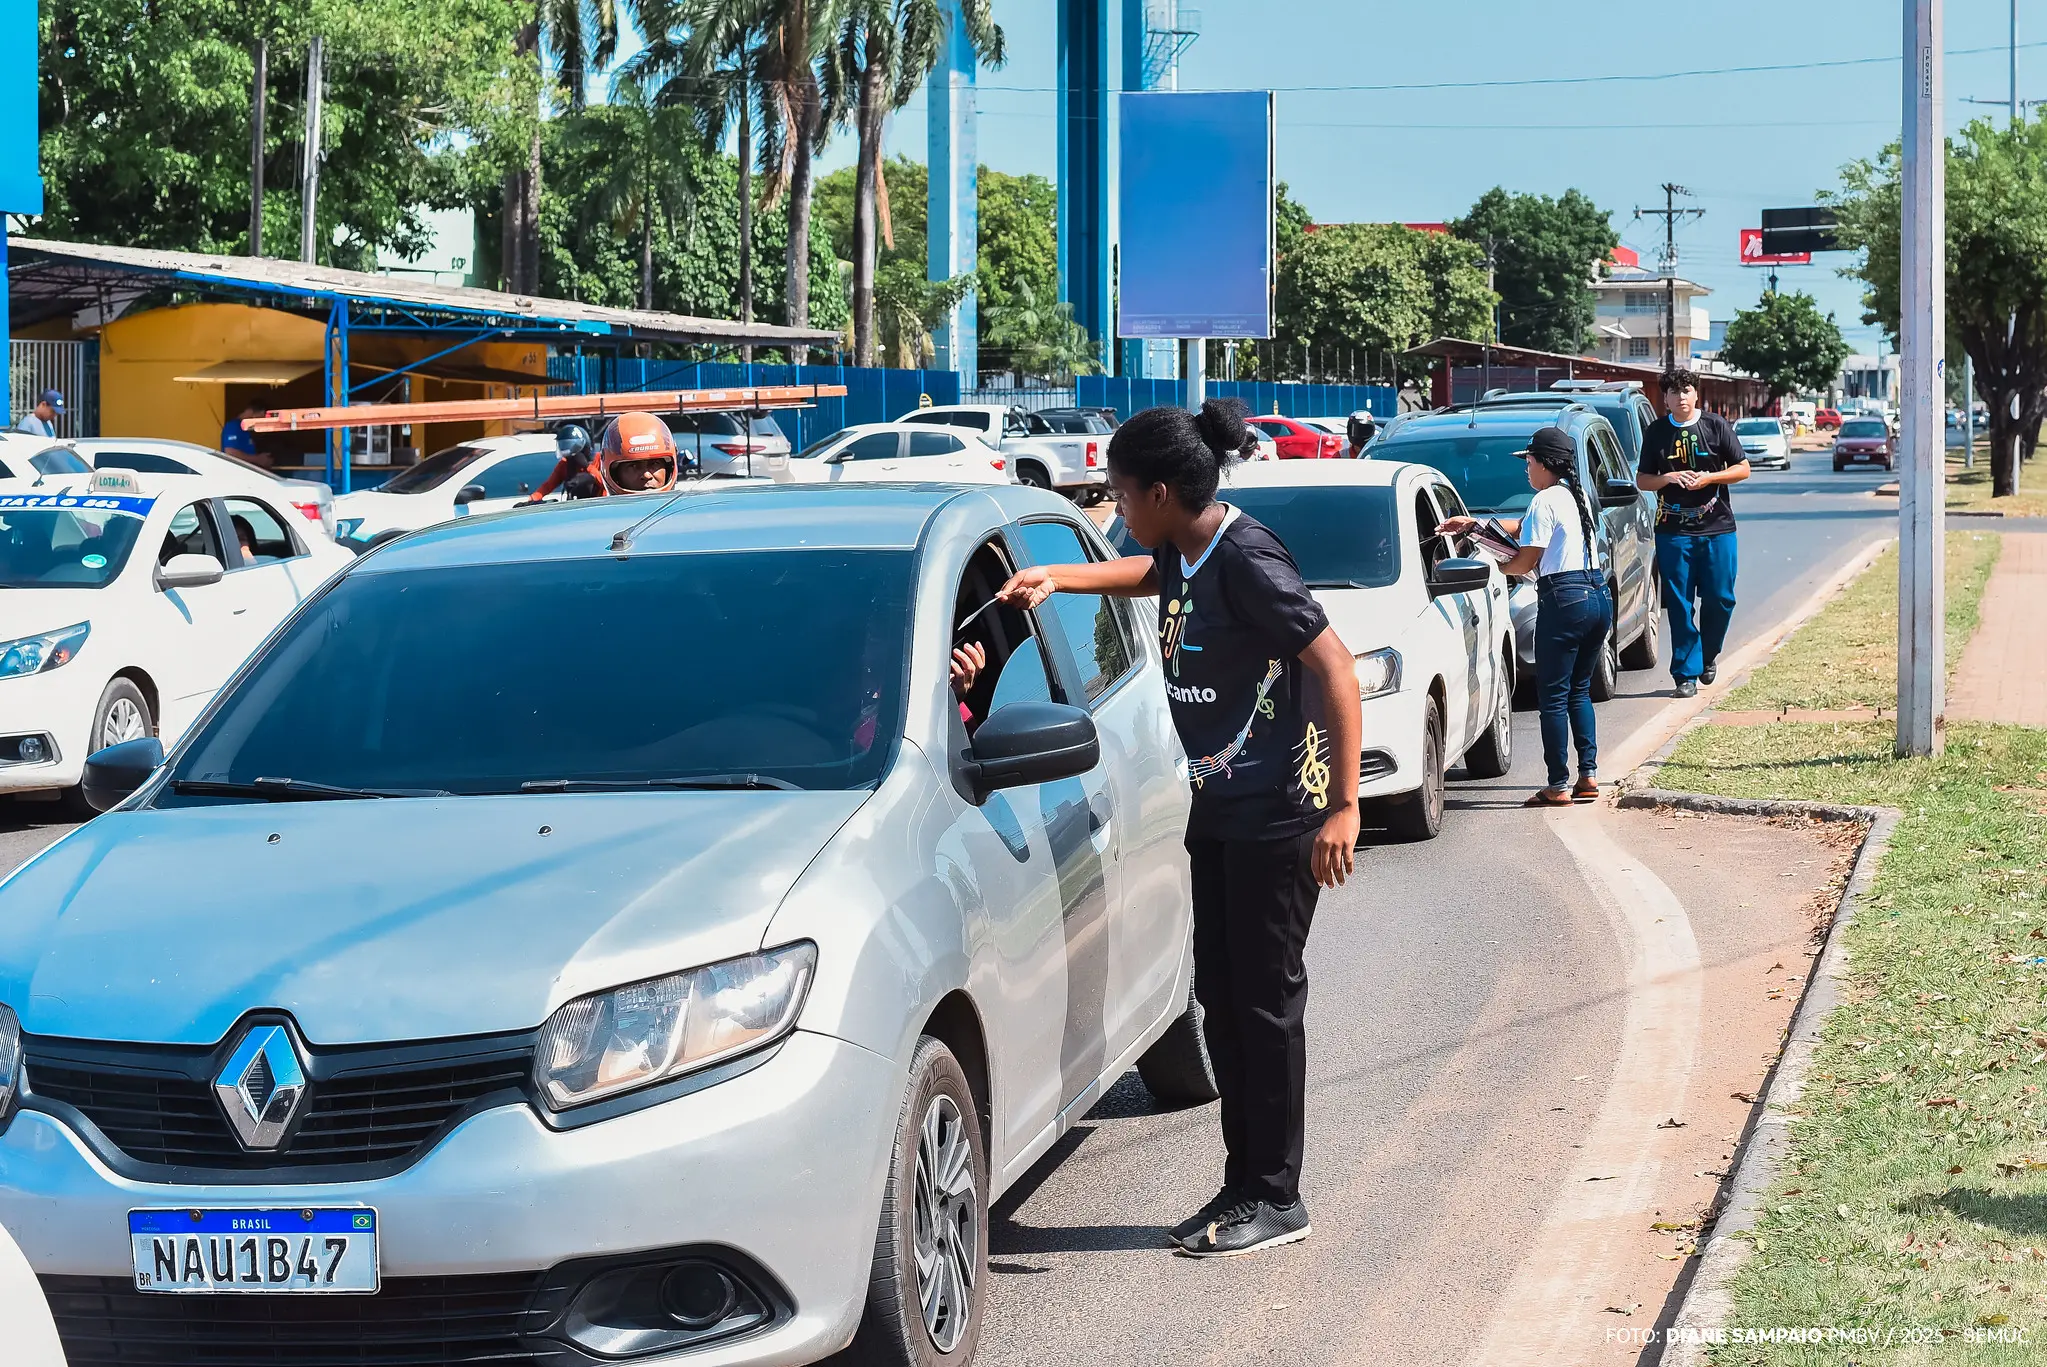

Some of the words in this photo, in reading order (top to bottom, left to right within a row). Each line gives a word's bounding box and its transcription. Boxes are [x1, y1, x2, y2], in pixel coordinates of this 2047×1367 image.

[232, 1218, 271, 1230] BRASIL
[153, 1237, 348, 1283] NAU1B47
[139, 1272, 152, 1286] BR
